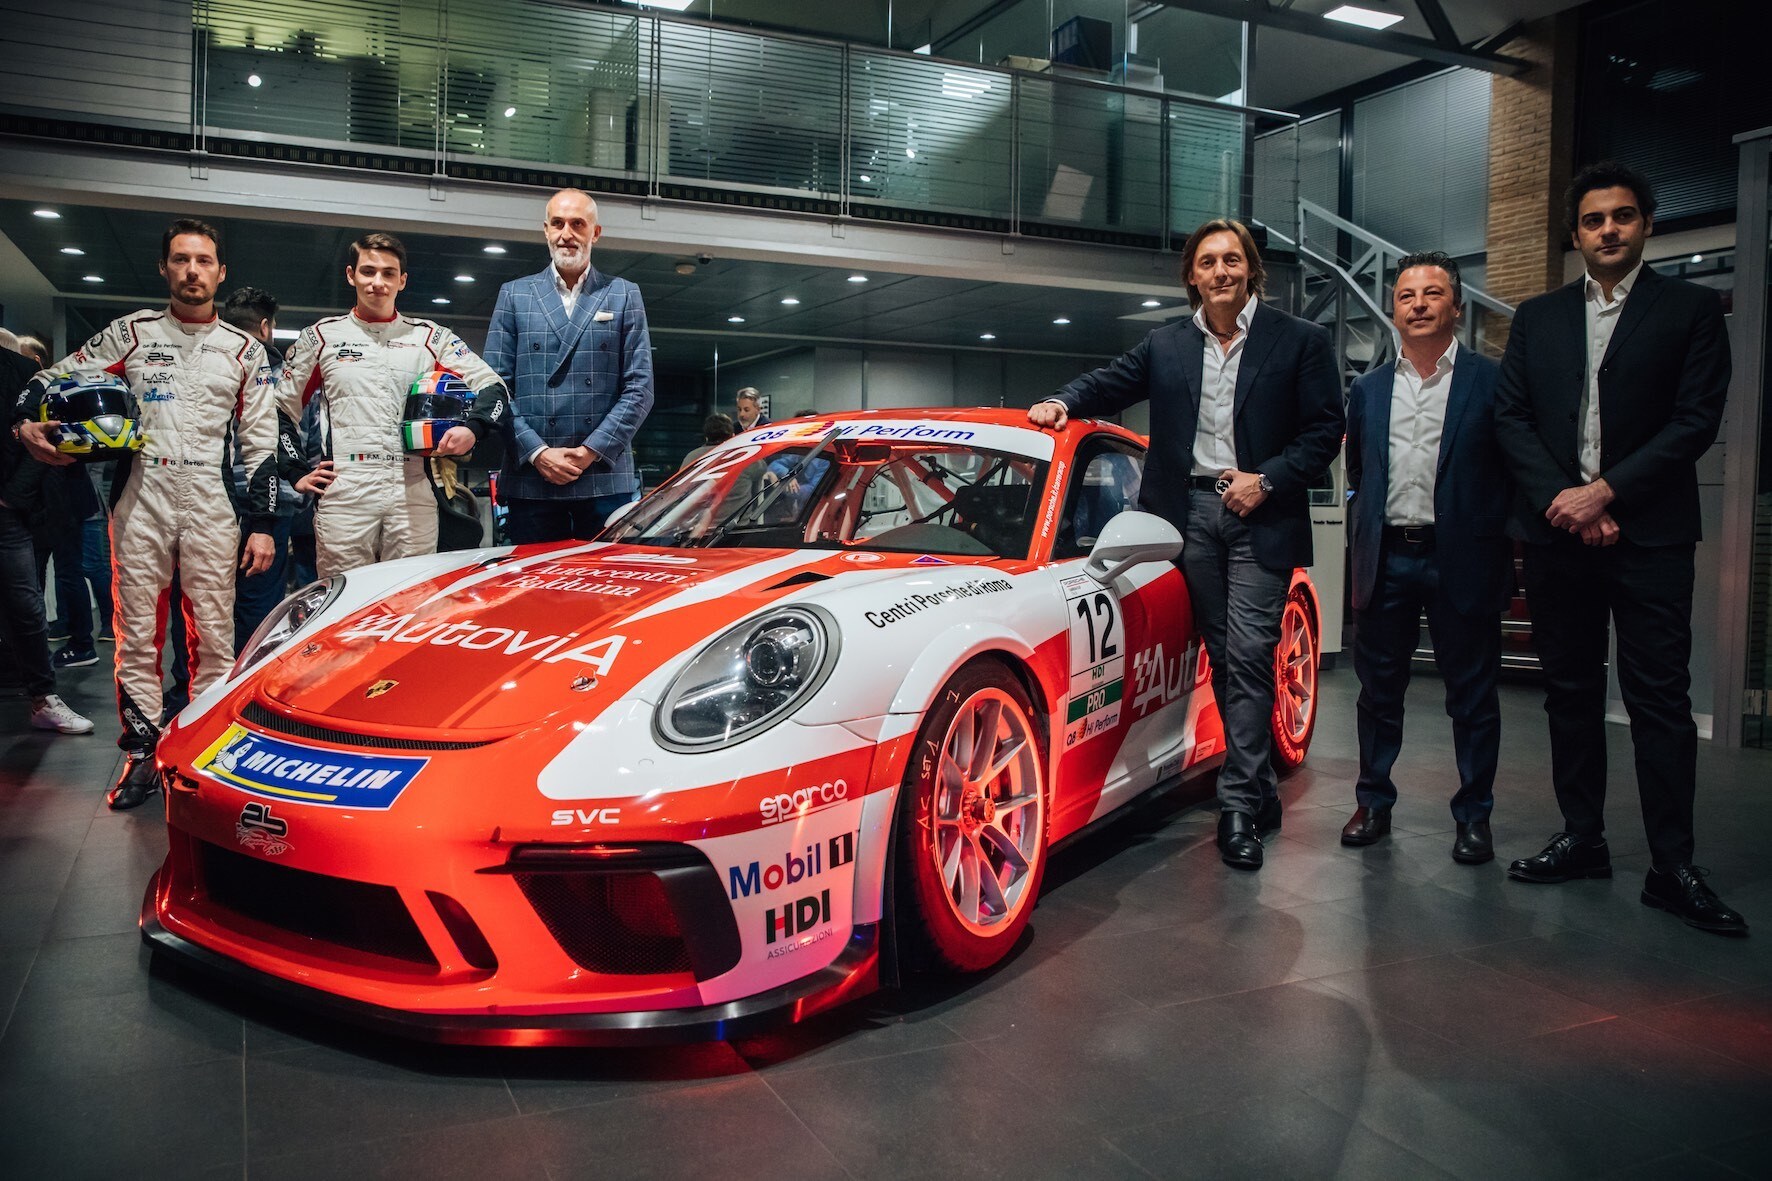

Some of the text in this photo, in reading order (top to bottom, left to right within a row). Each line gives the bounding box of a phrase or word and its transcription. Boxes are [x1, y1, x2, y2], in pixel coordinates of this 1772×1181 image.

[142, 372, 175, 382] LASA
[858, 425, 976, 441] Perform
[864, 598, 918, 629] Centri
[911, 586, 973, 612] Porsche
[1076, 593, 1117, 664] 12
[1086, 689, 1106, 714] PRO
[1094, 713, 1118, 732] Perform
[241, 750, 403, 790] MICHELIN
[921, 754, 932, 780] SET
[550, 808, 621, 826] SVC
[759, 778, 848, 823] sparco
[729, 843, 822, 900] Mobil
[766, 888, 831, 945] HDI
